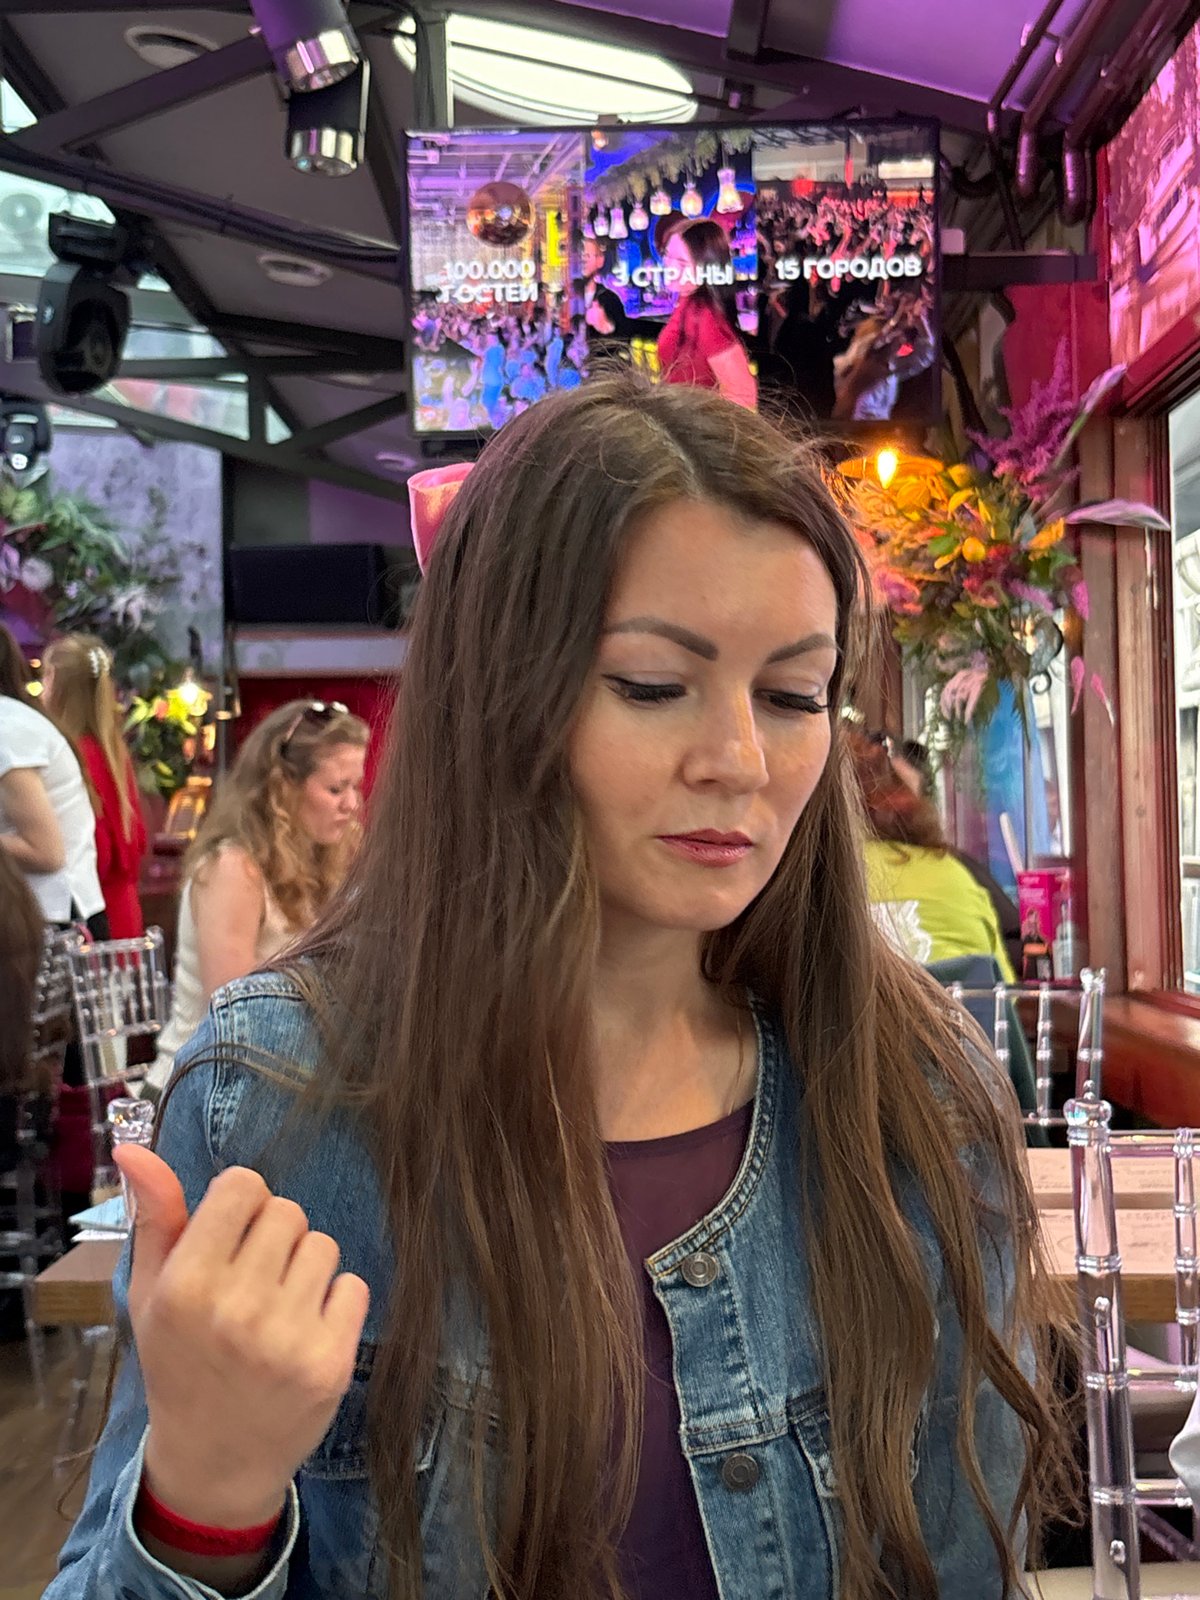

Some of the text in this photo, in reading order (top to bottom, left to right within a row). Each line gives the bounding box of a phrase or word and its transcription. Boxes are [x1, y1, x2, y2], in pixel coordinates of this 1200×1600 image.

[443, 260, 536, 280] 100.000
[613, 264, 733, 288] 3 СТРАНЫ
[776, 257, 923, 281] 15 ГОРОДОВ
